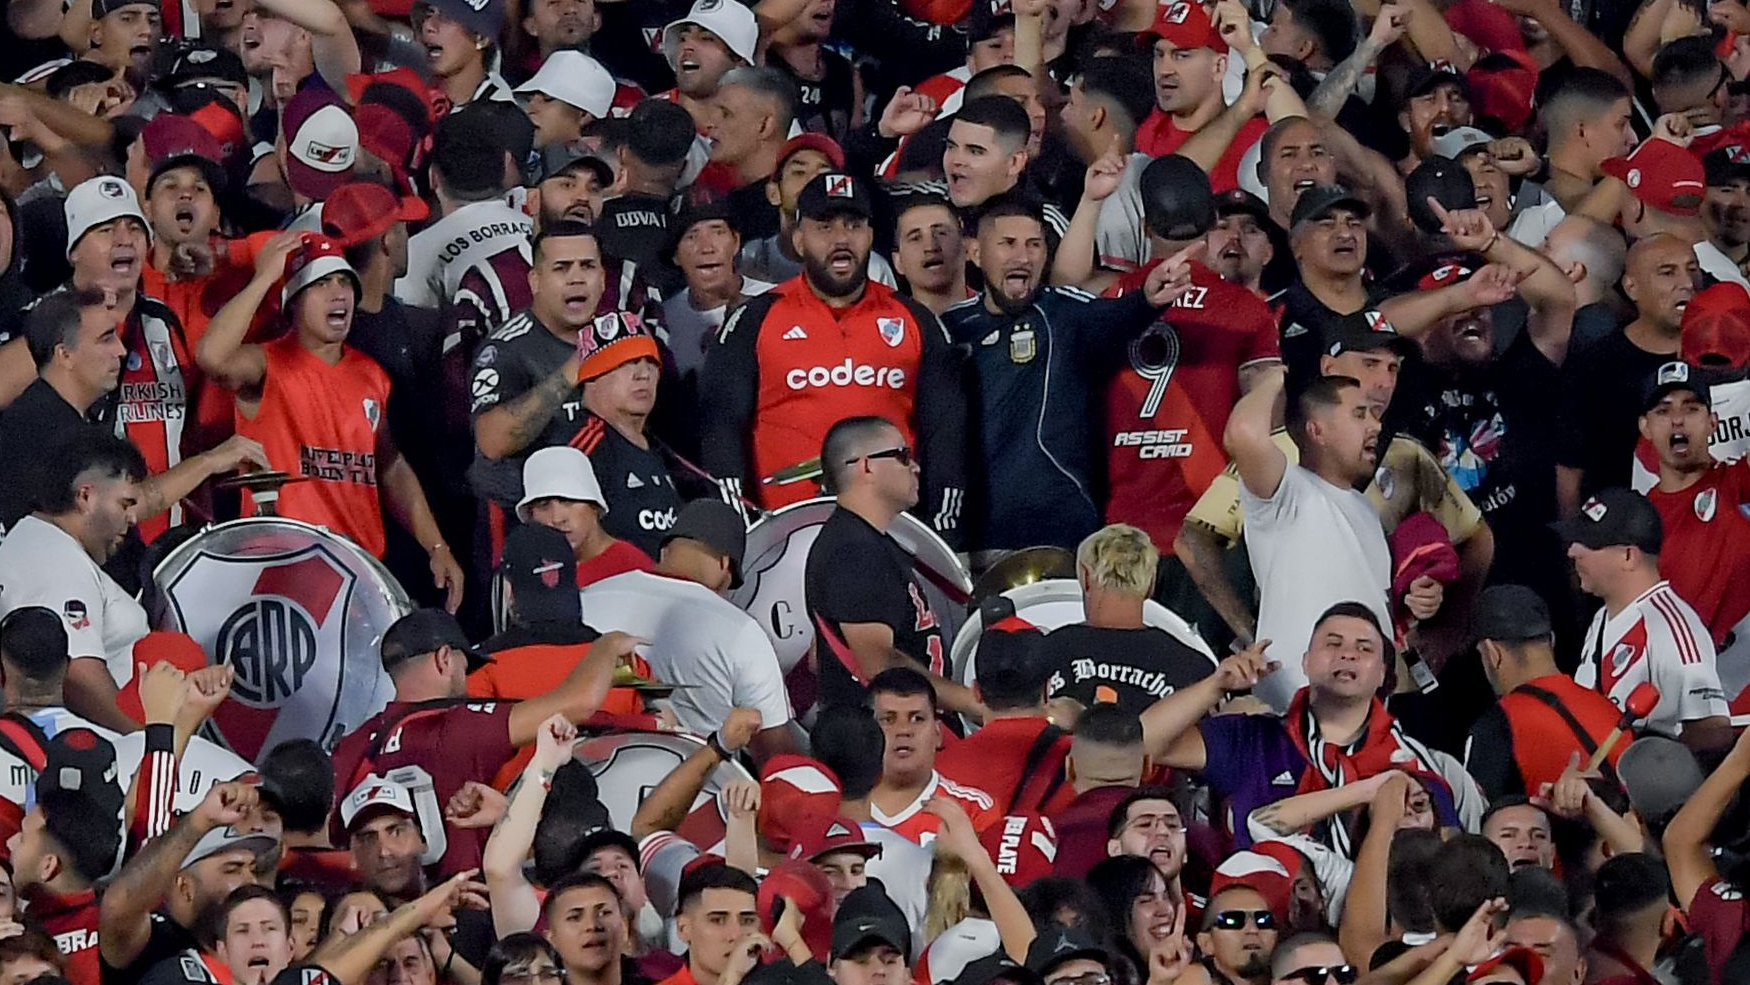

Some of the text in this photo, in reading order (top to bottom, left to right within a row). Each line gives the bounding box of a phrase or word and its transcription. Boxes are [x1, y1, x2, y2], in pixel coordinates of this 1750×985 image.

[800, 85, 821, 105] 24
[438, 222, 533, 264] LOS BORRAC
[786, 358, 906, 390] codere
[1128, 320, 1182, 418] 9
[122, 381, 181, 400] RKISH
[119, 403, 183, 421] RLINES
[1114, 429, 1188, 447] ASSIST
[1139, 443, 1193, 459] CARD
